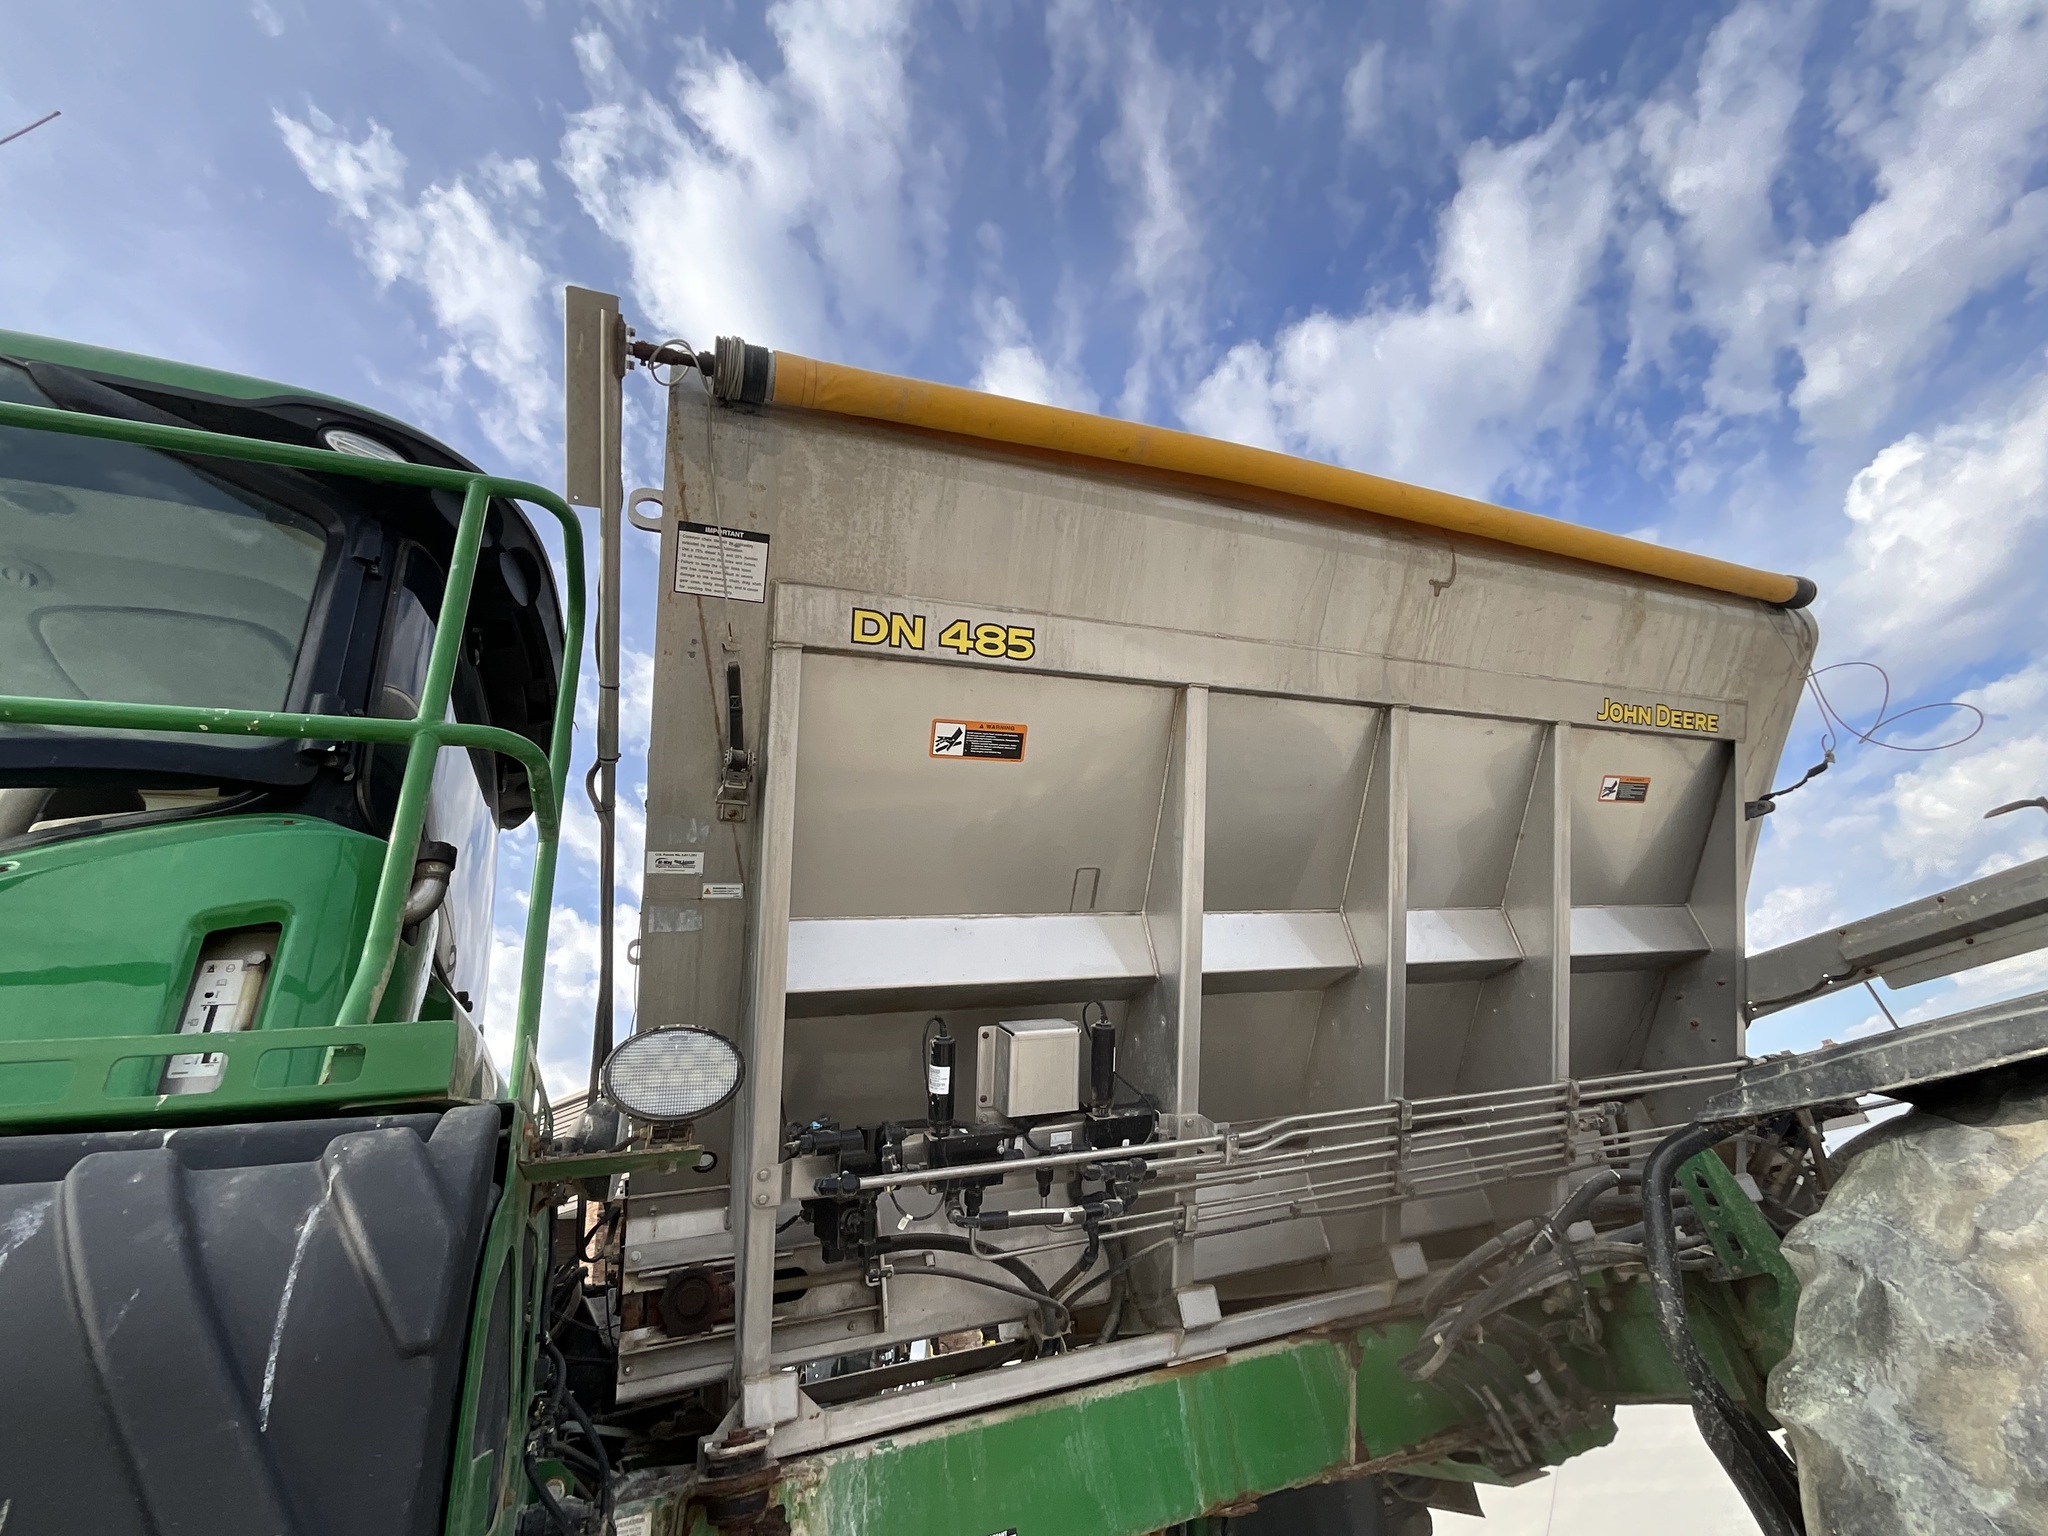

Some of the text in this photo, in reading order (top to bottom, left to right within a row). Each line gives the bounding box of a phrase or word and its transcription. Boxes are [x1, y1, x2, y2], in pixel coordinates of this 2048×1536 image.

[851, 607, 1035, 661] DN 485
[1597, 697, 1719, 733] JOHN DEERE
